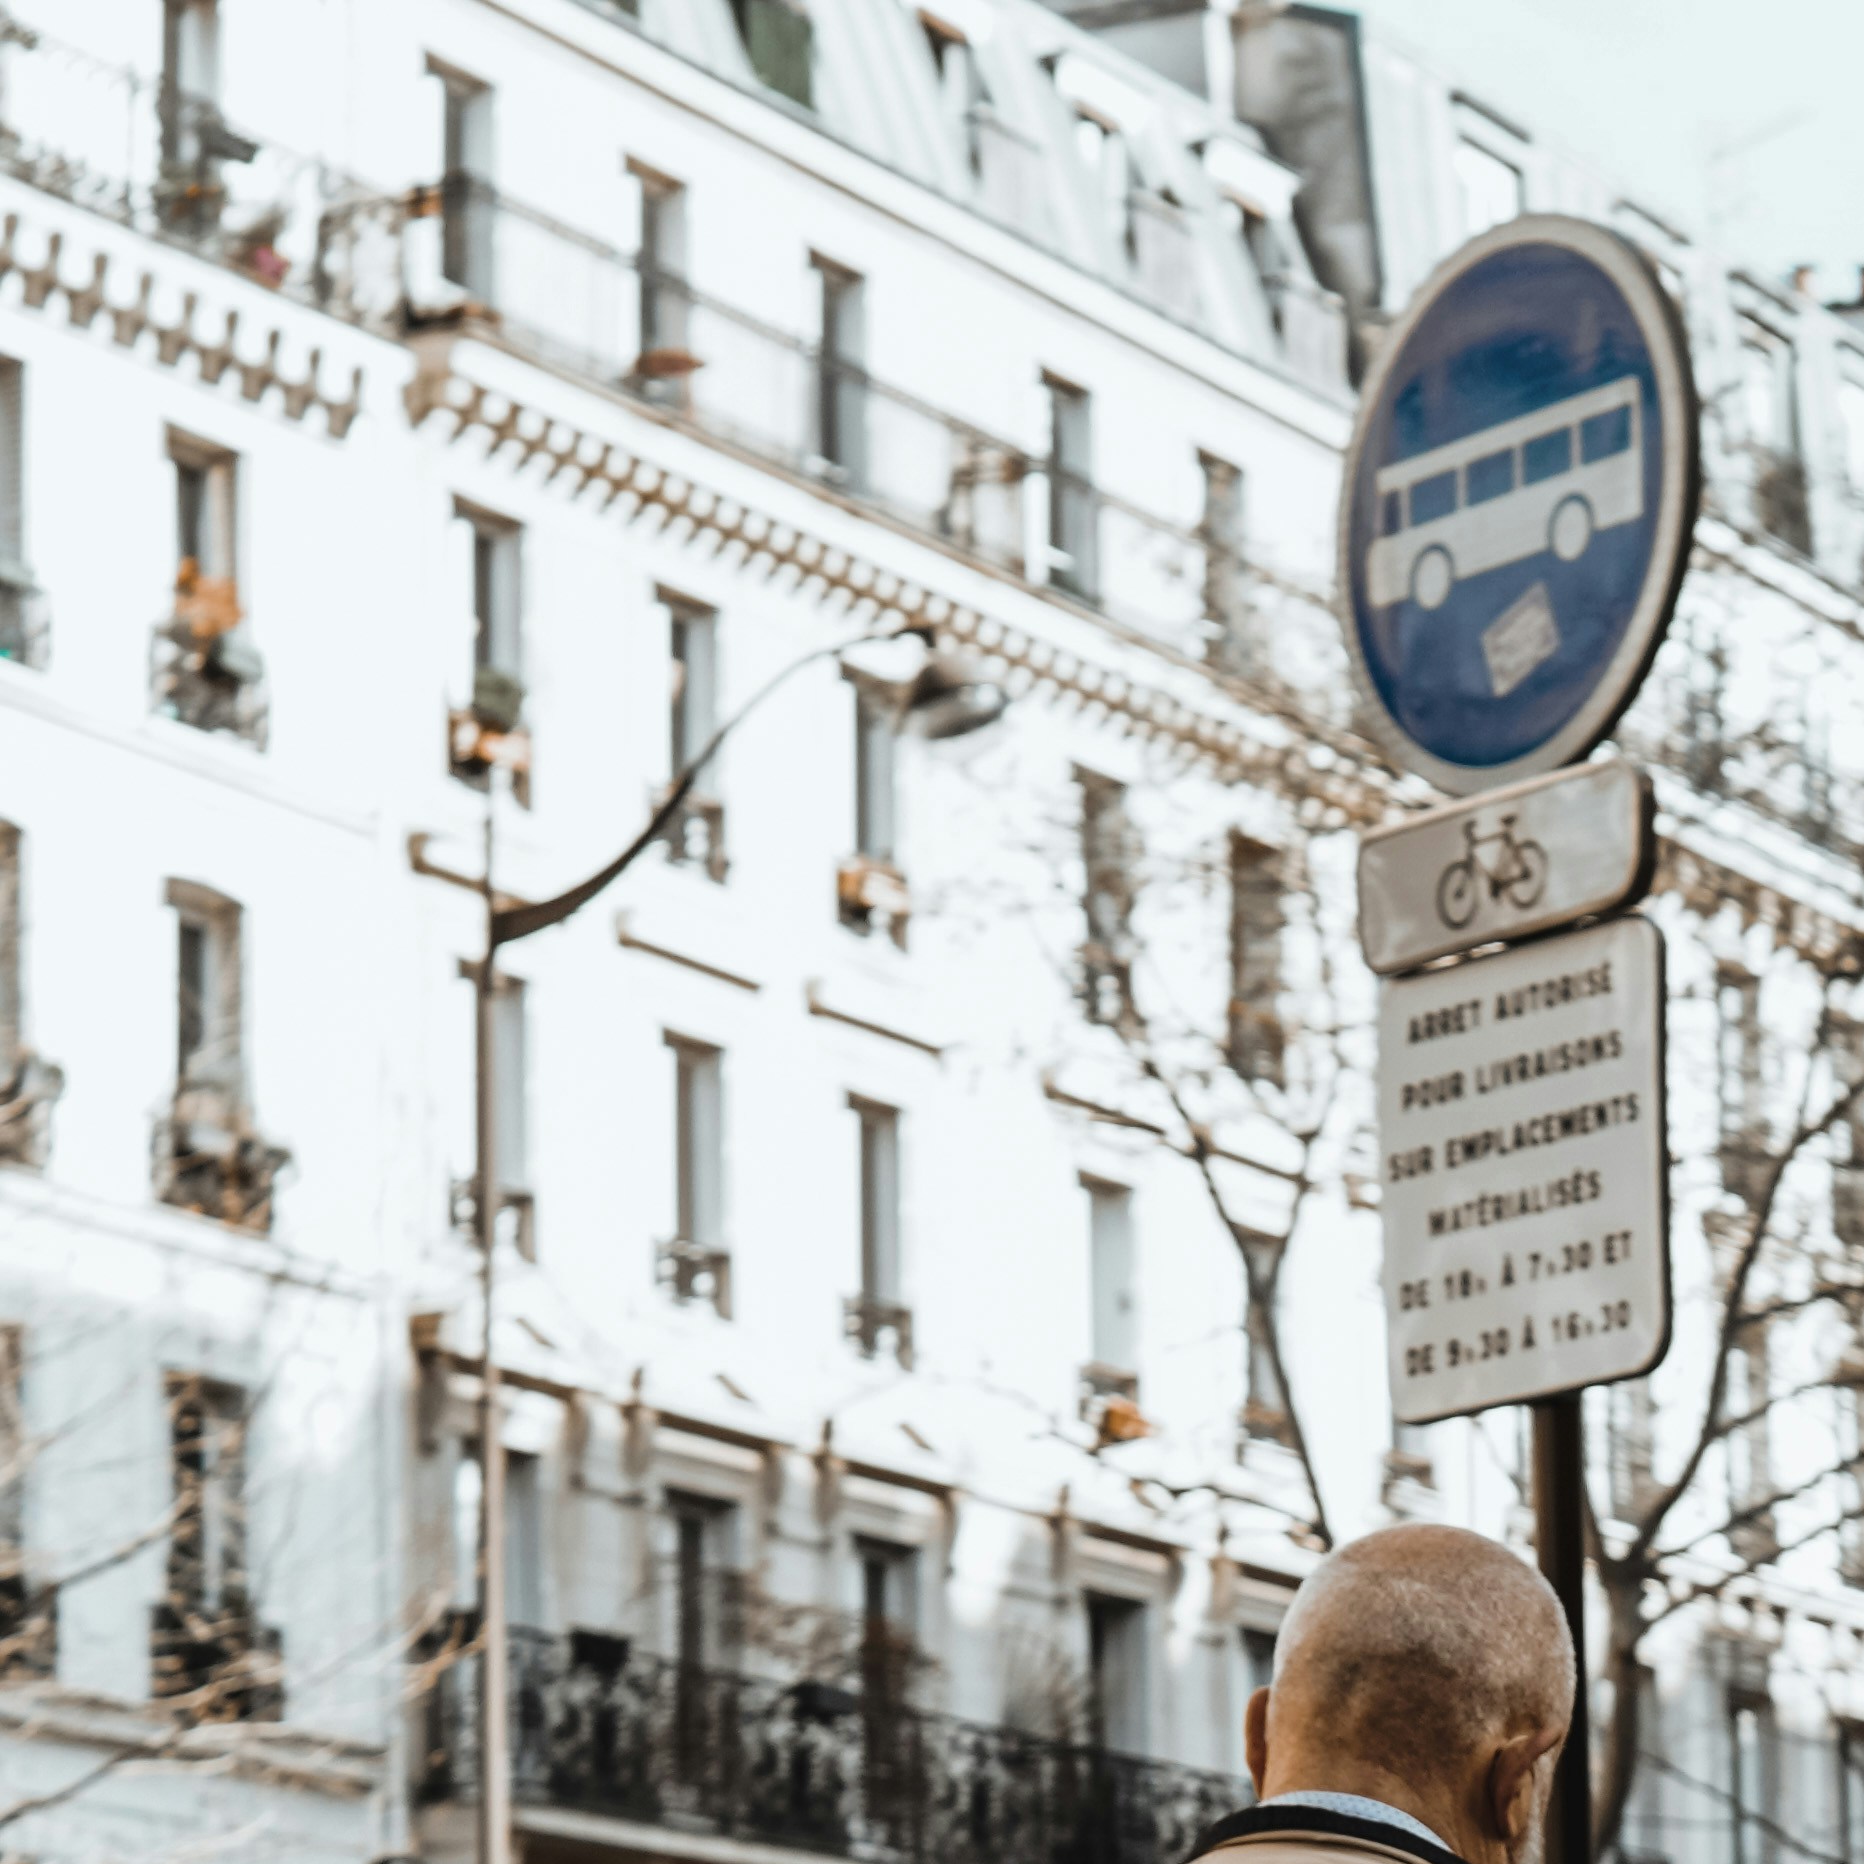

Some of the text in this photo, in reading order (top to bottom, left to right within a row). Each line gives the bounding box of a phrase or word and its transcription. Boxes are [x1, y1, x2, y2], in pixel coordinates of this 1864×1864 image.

[1400, 1030, 1623, 1112] POUR LIVRAISONS
[1388, 1092, 1640, 1183] SUR EMPLACEMENTS
[1400, 1278, 1430, 1311] DE
[1604, 1230, 1632, 1265] ET
[1406, 1343, 1435, 1377] DE
